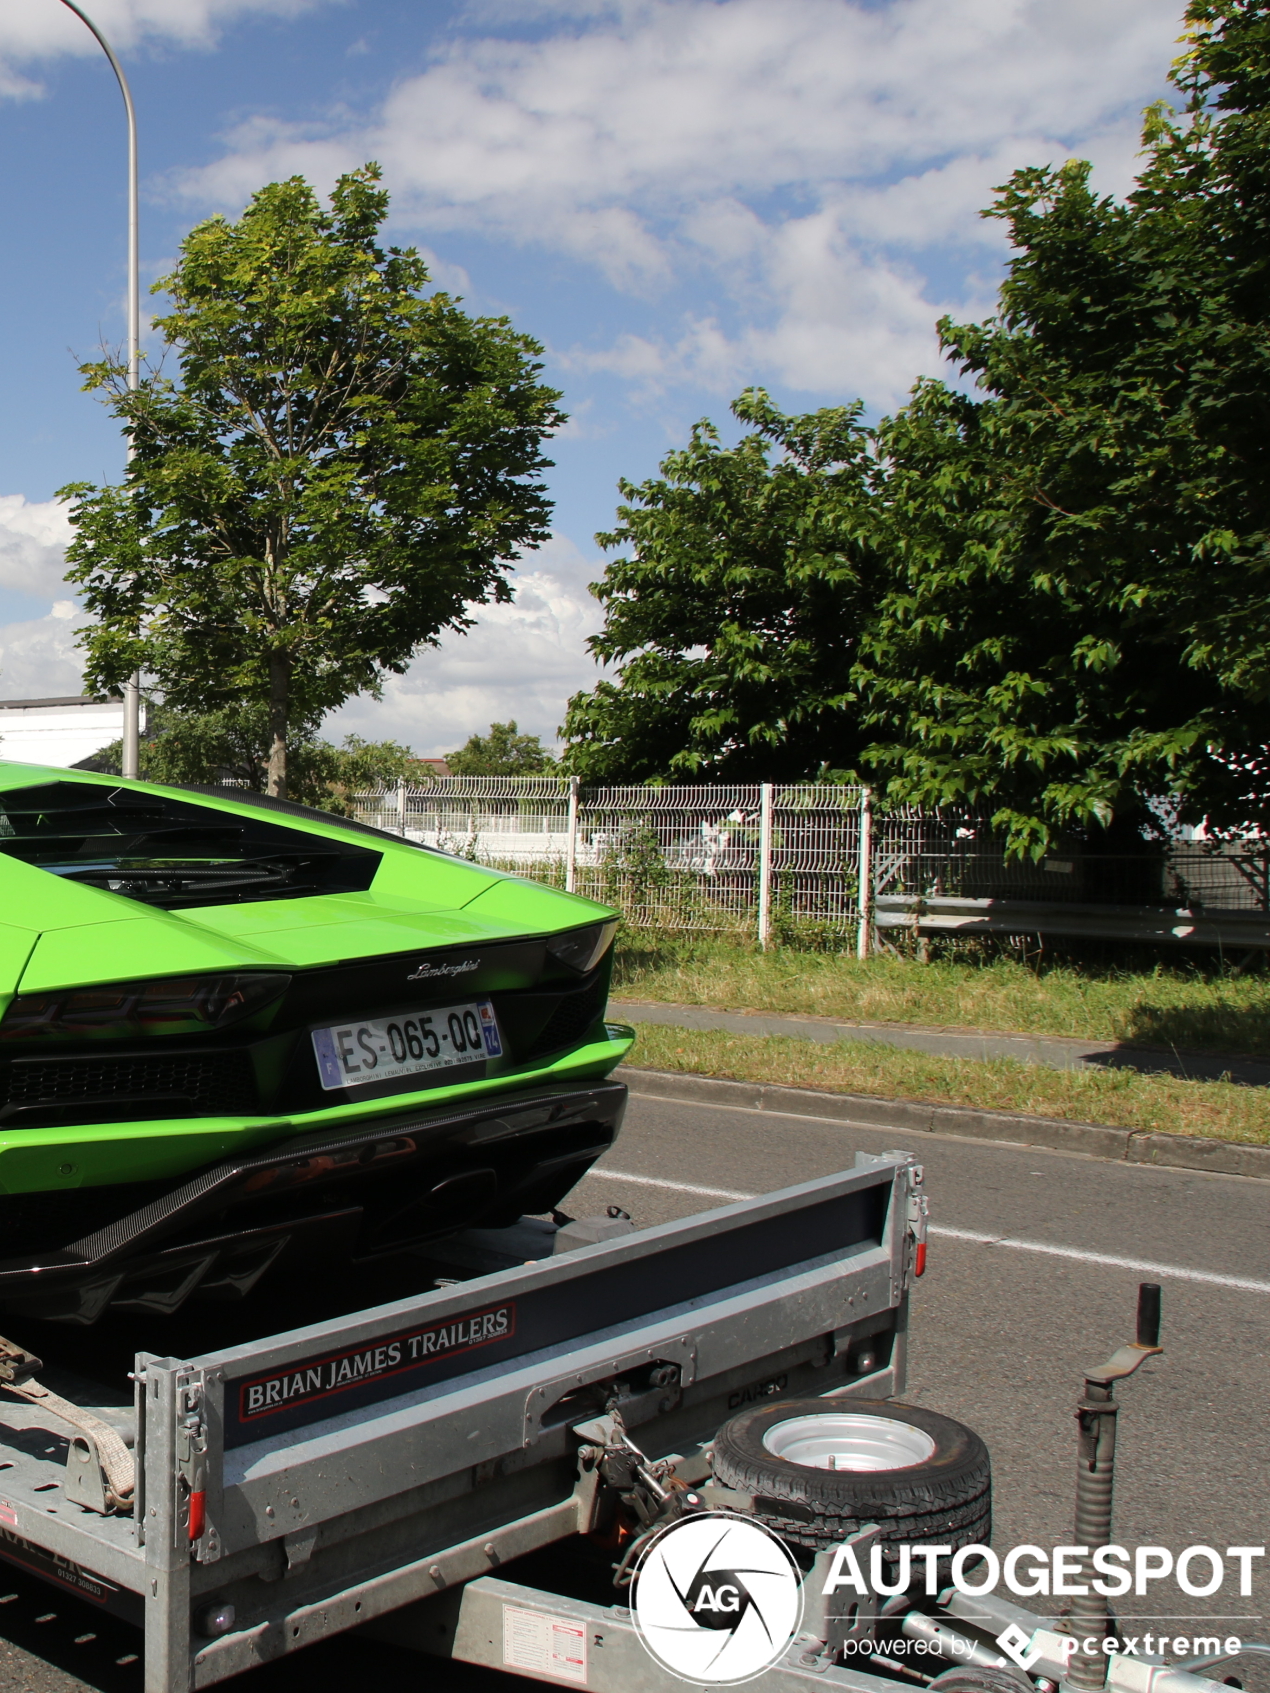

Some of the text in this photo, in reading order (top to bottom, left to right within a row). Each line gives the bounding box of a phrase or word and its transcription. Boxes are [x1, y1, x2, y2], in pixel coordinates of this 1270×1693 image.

[407, 959, 480, 980] Lamborghini
[337, 1010, 482, 1074] ES-065-QQ
[248, 1309, 508, 1410] BRIAN JAMES TRAILERS
[57, 1568, 101, 1596] 01327 308833
